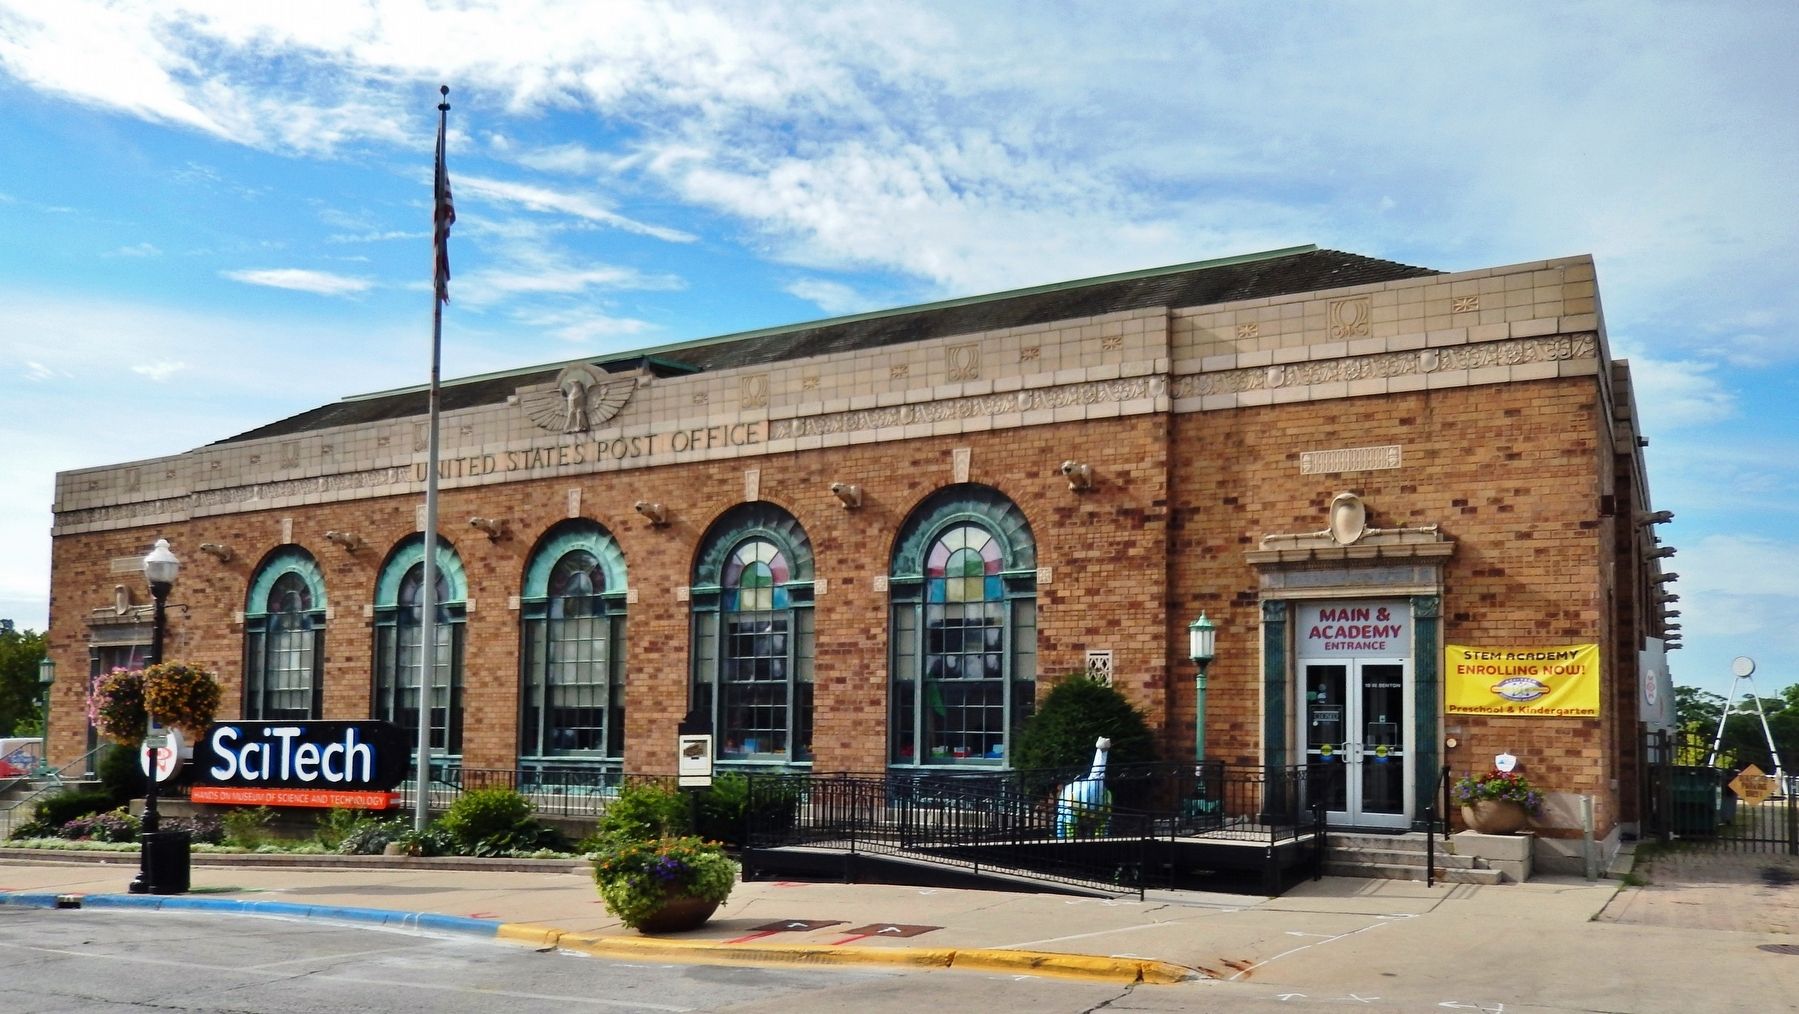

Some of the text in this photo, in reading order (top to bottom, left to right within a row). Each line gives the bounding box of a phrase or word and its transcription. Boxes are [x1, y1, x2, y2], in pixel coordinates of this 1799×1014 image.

[507, 444, 584, 472] STATES
[597, 434, 657, 462] POST
[671, 422, 761, 453] OFFICE
[1319, 607, 1391, 622] MAIN &
[1308, 624, 1402, 639] ACADEMY
[1324, 641, 1387, 650] ENTRANCE
[1463, 650, 1579, 661] STEM ACADEMY
[1457, 664, 1586, 675] ENROLLING NOW!
[1449, 704, 1595, 716] Preschool & Kindergarten
[211, 726, 373, 783] SciTech
[266, 793, 277, 802] OF
[277, 793, 309, 803] SCIENCE
[311, 794, 328, 804] AND
[330, 795, 385, 806] TECHNOLOGY
